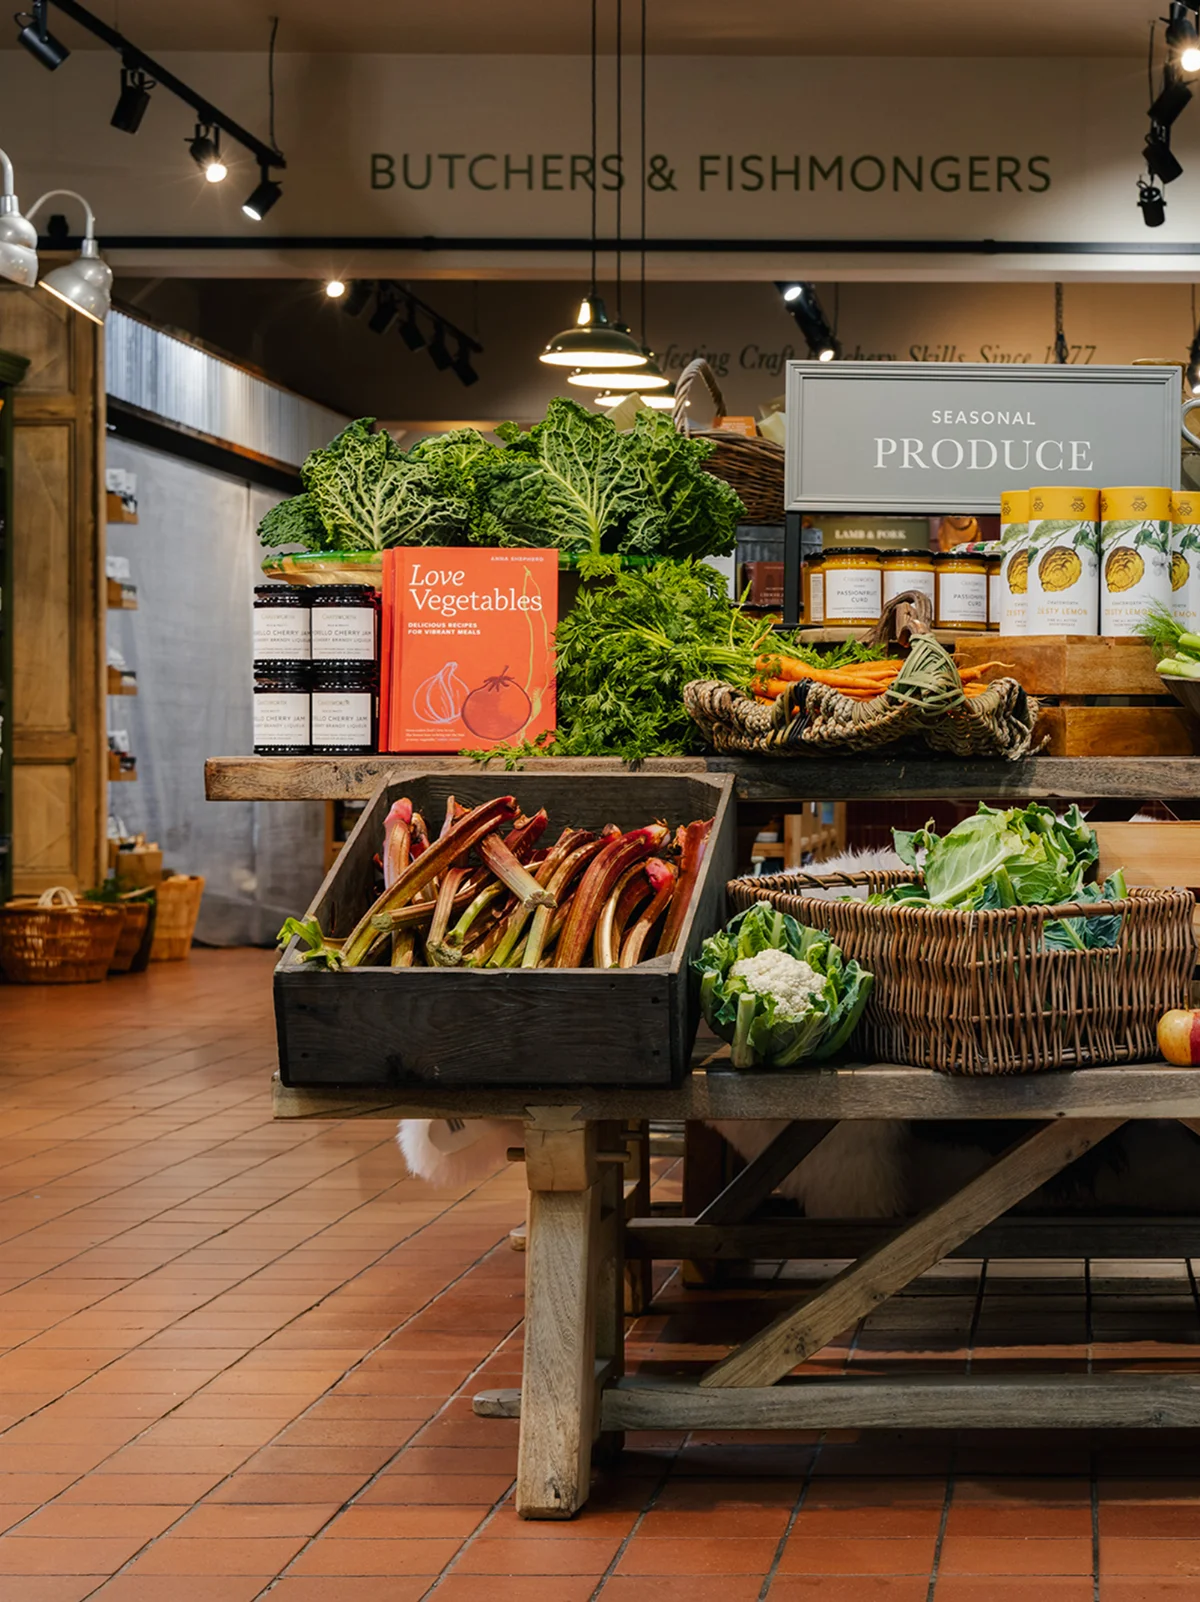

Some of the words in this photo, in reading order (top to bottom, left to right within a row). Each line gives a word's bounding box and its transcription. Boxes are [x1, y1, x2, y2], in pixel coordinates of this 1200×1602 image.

[370, 153, 625, 191] BUTCHERS
[647, 153, 678, 192] &
[699, 154, 1051, 192] FISHMONGERS
[1043, 345, 1098, 365] 177
[932, 410, 1036, 425] SEASONAL
[873, 437, 1094, 471] PRODUCE
[835, 530, 865, 540] LAMB
[866, 530, 875, 540] &
[877, 530, 906, 540] PORK
[409, 564, 465, 587] Love
[409, 588, 543, 617] Vegetables
[1037, 607, 1059, 615] ZESTY
[1062, 608, 1088, 616] LEMON
[1174, 610, 1197, 618] EMON
